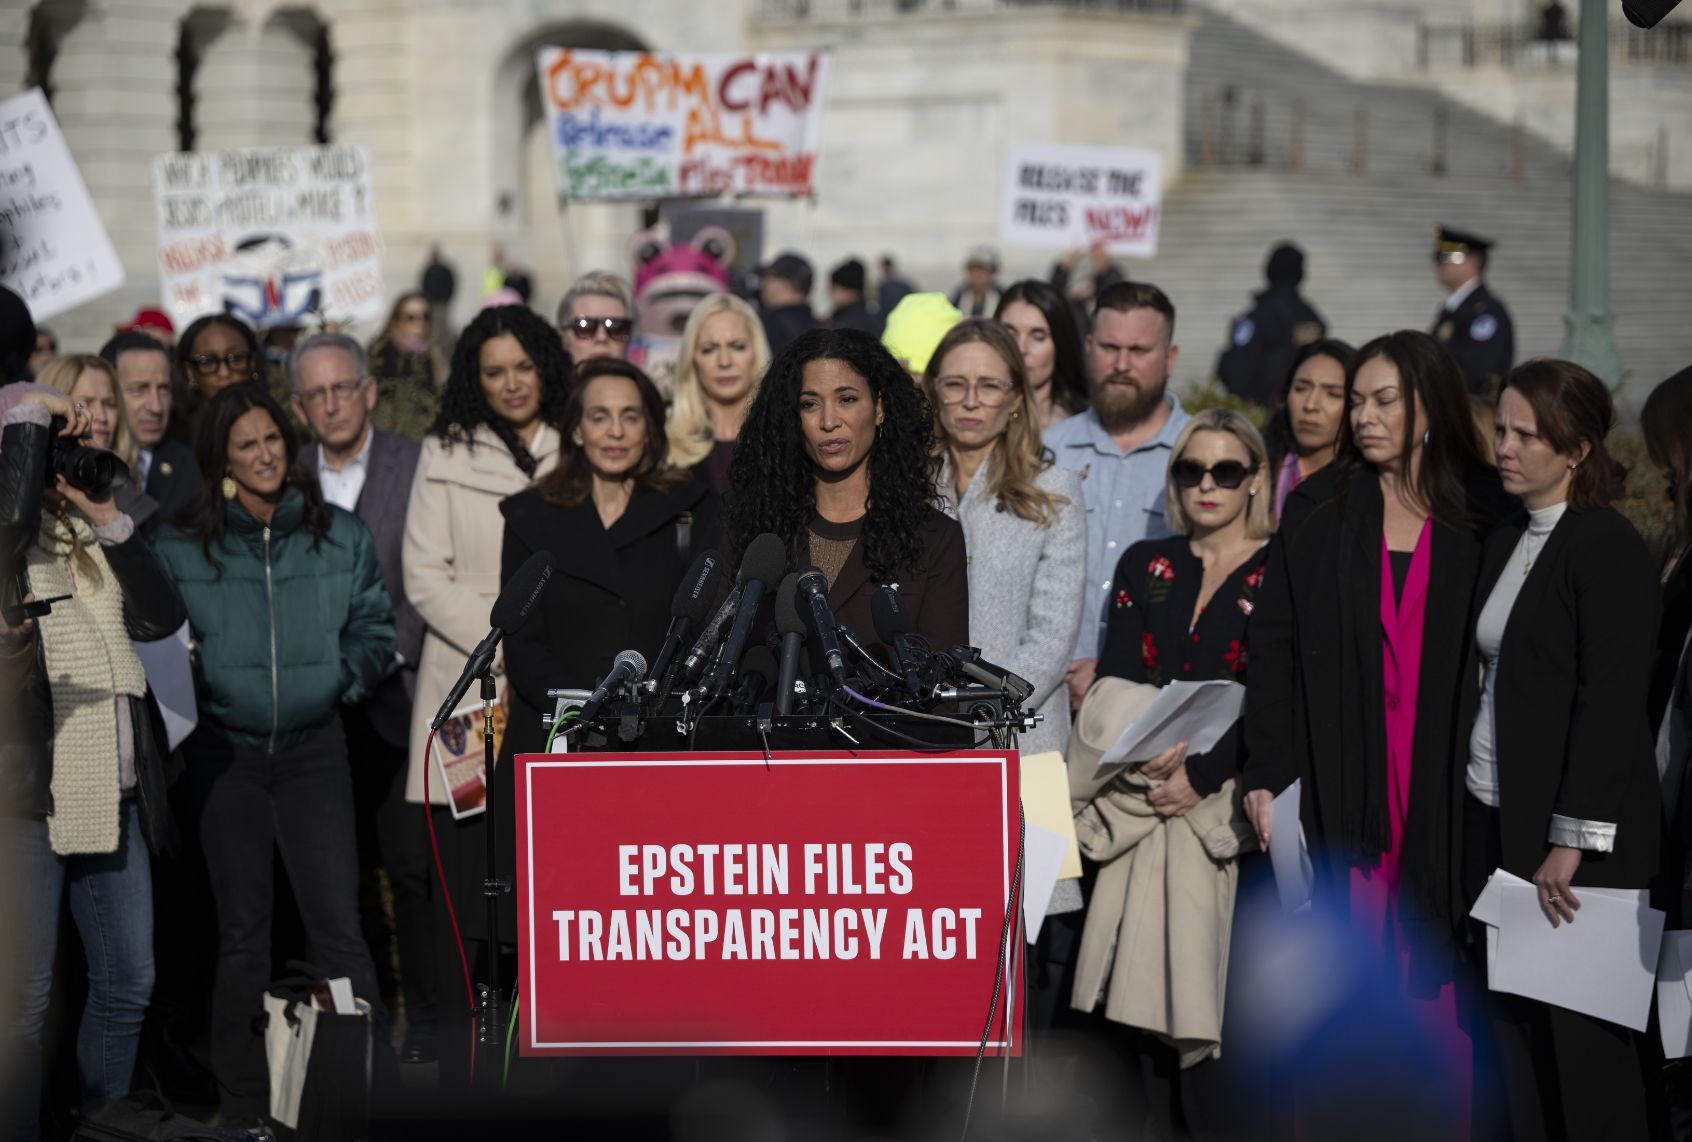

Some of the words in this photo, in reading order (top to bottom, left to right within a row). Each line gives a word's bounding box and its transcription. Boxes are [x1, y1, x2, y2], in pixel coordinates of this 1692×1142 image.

[718, 55, 817, 114] CAN
[619, 844, 788, 895] EPSTEIN
[804, 843, 912, 894] FILES
[553, 908, 888, 960] TRANSPARENCY
[903, 908, 981, 959] ACT
